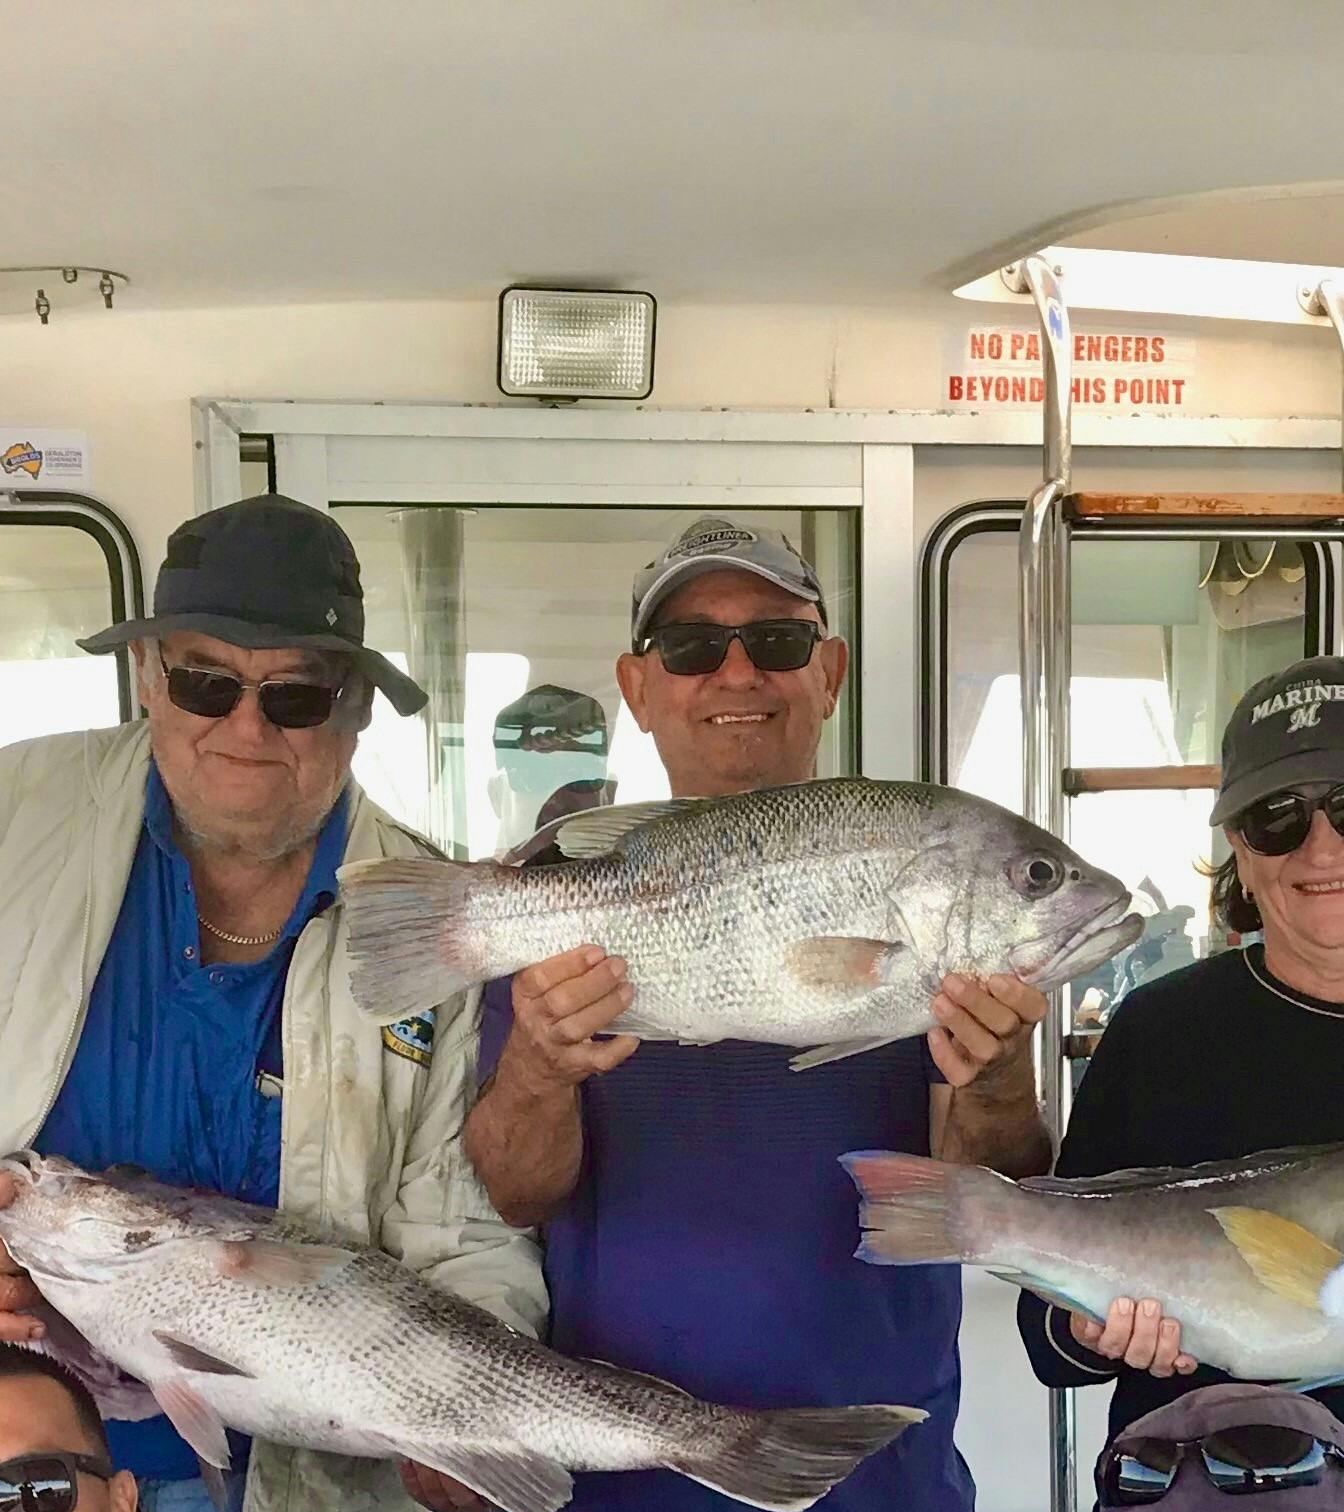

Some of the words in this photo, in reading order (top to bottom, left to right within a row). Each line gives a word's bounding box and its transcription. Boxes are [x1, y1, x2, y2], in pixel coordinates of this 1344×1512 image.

[970, 333, 1003, 360] NO
[1011, 333, 1165, 363] PAENGERS
[949, 375, 1045, 404] BEYOND
[1068, 377, 1106, 404] HIS
[1114, 378, 1185, 405] POINT
